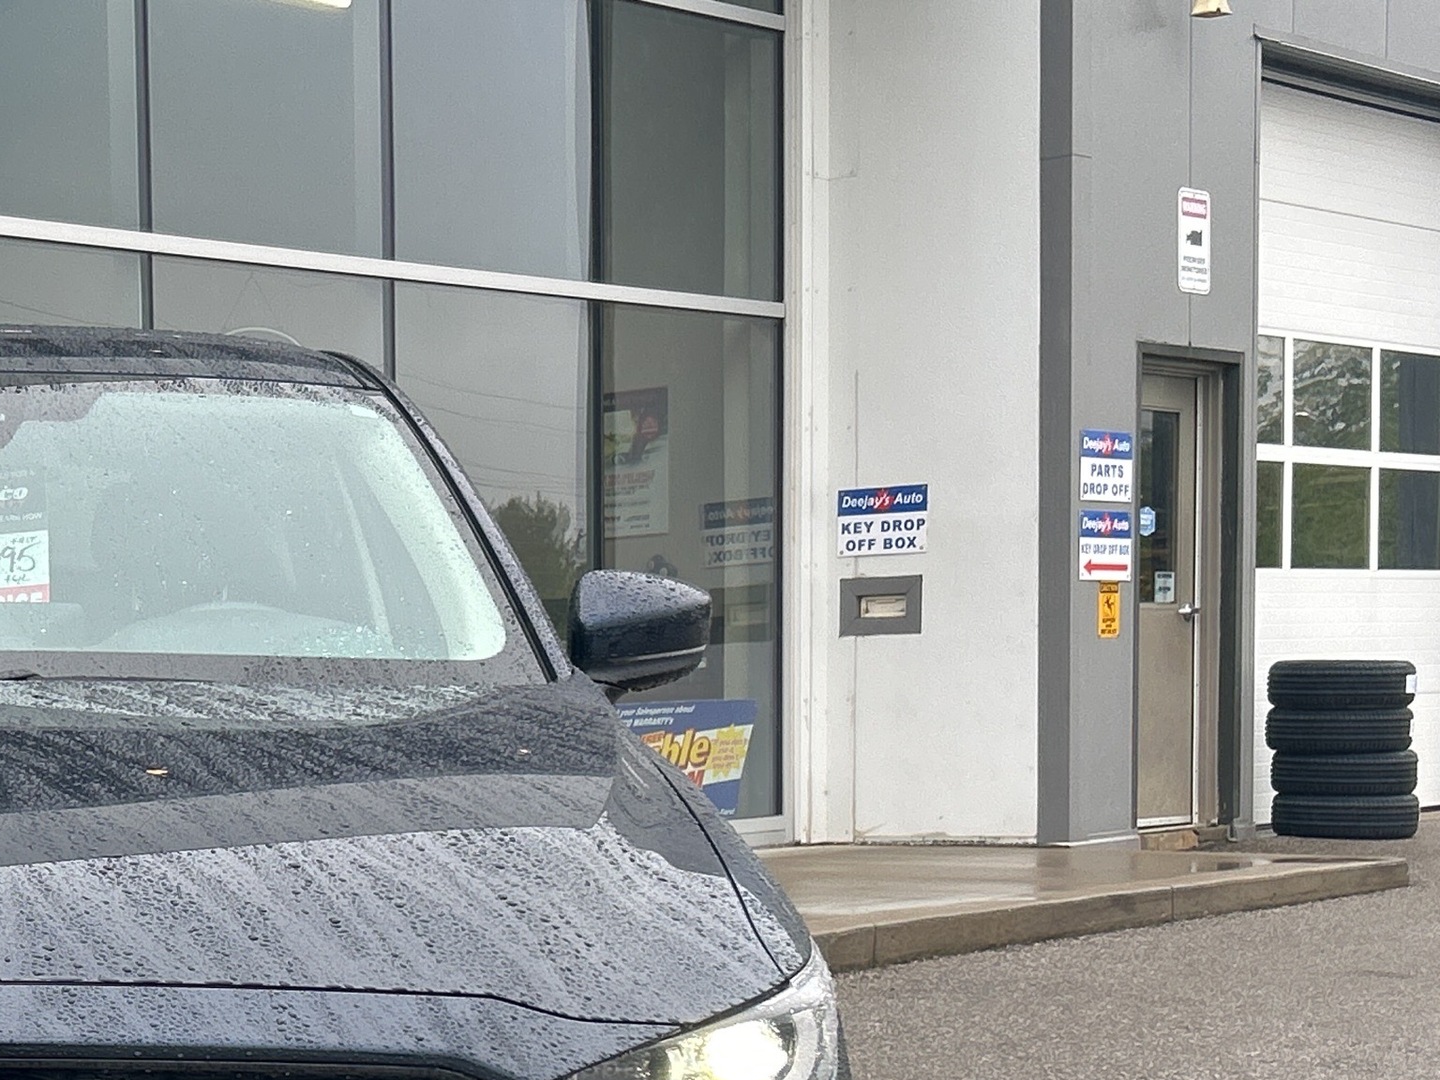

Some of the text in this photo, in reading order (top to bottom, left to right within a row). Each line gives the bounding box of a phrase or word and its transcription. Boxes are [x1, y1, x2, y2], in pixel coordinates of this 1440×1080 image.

[1083, 436, 1130, 453] Deejay's Auto
[1090, 463, 1124, 479] PARTS
[1082, 482, 1130, 497] DROP OFF
[842, 492, 924, 510] Deejay's Auto
[841, 518, 926, 535] KEY DROP
[1082, 516, 1111, 533] Deejay's
[1112, 518, 1130, 531] Auto
[846, 536, 917, 552] OFF BOX
[1081, 544, 1130, 555] KEY DROP OFF BOX
